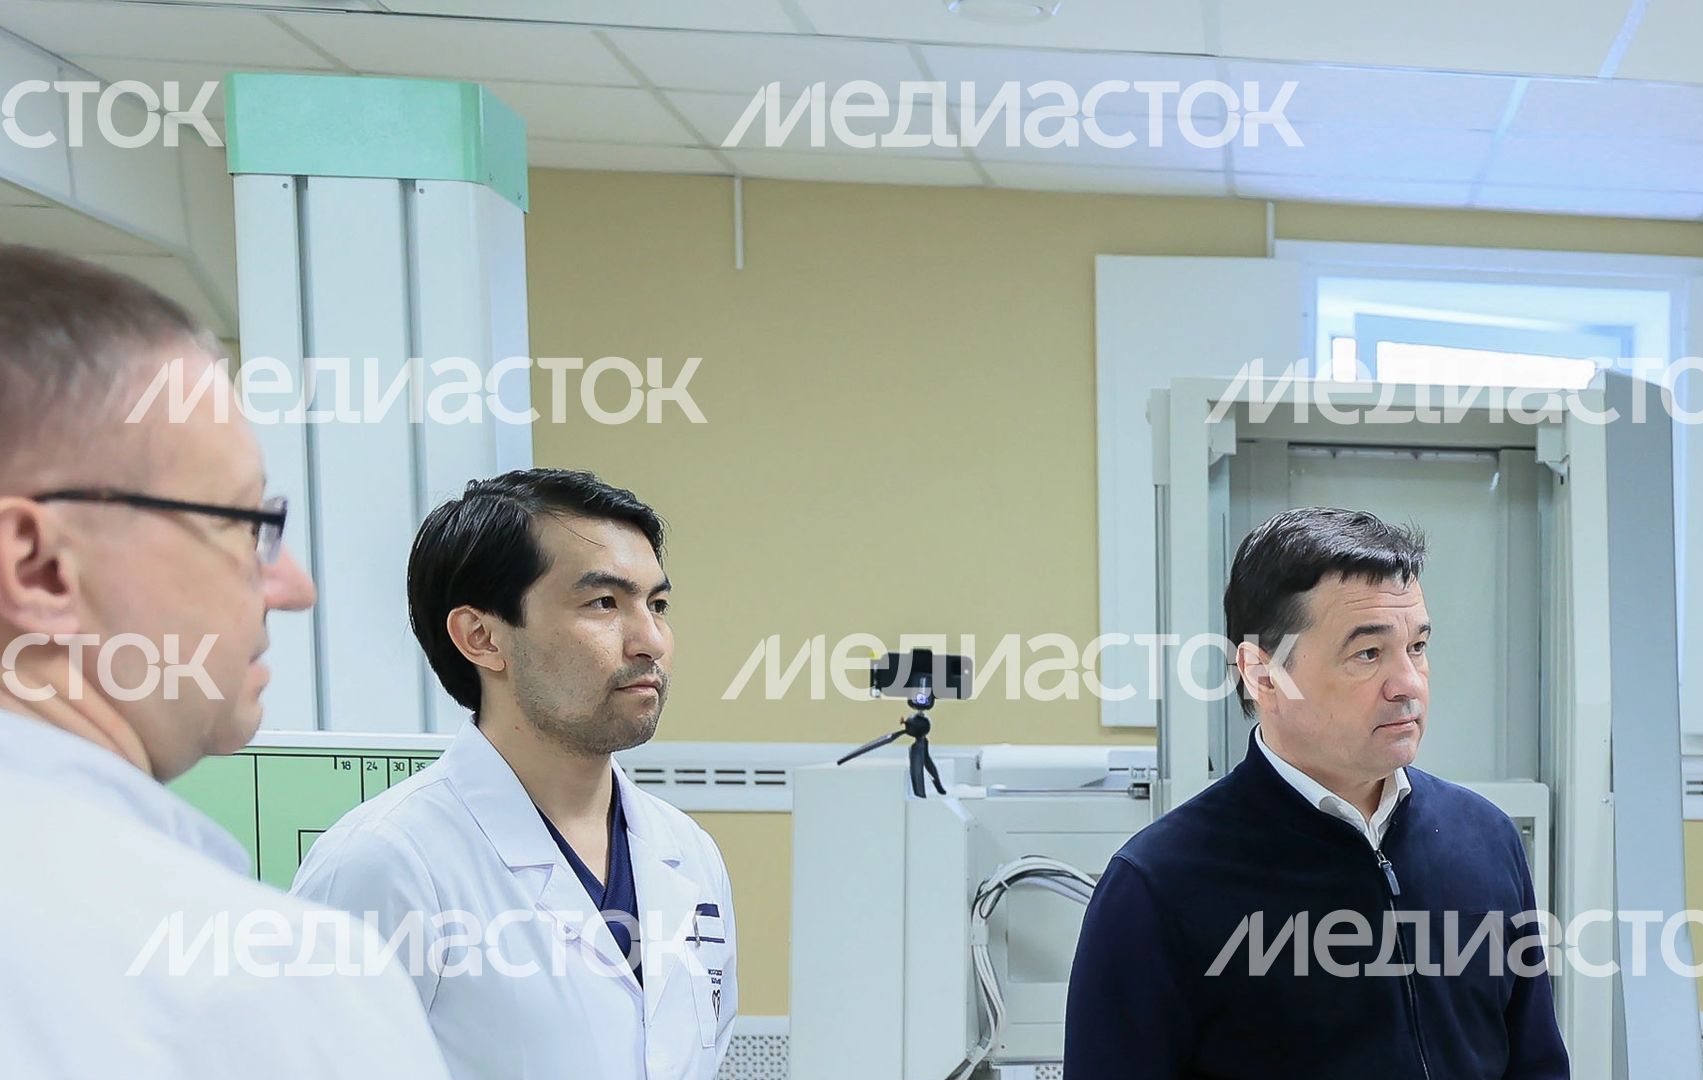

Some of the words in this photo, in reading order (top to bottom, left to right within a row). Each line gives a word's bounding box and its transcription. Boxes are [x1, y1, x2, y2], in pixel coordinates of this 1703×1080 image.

[341, 761, 351, 770] 18
[366, 761, 378, 771] 24
[393, 762, 405, 772] 30
